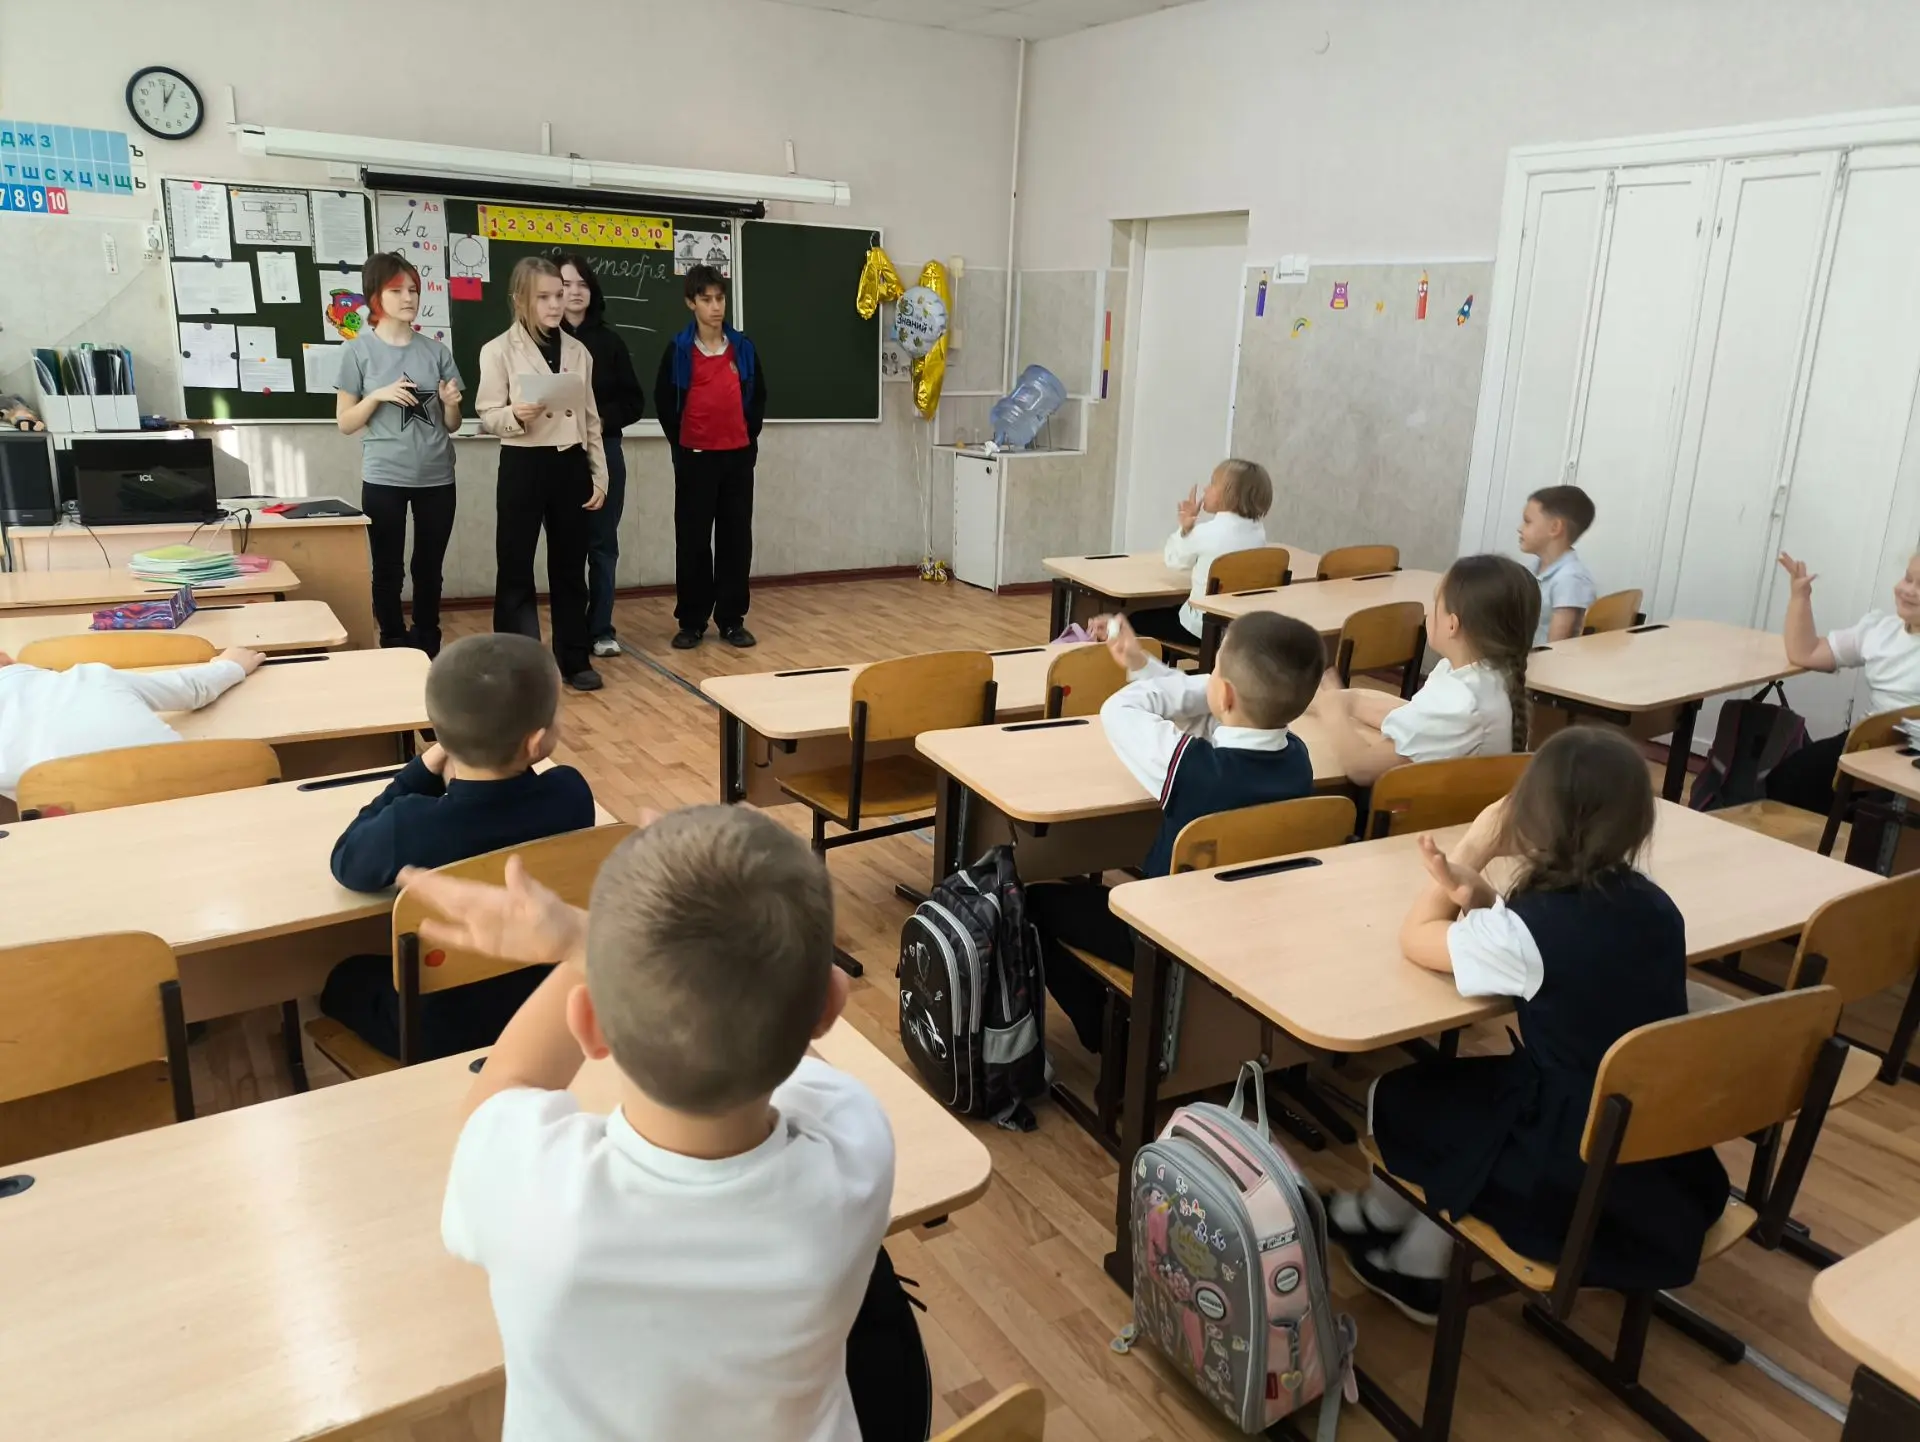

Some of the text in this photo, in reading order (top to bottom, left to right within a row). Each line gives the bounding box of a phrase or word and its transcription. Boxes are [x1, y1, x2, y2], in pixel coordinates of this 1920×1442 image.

[18, 132, 35, 147] Ж
[13, 189, 26, 209] 8
[31, 190, 43, 209] 9
[48, 190, 66, 210] 10
[491, 218, 497, 228] 1
[508, 218, 516, 230] 2
[527, 219, 535, 231] 3
[545, 221, 553, 232] 4
[563, 222, 572, 233] 5
[580, 223, 588, 234] 6
[598, 224, 605, 235] 7
[614, 226, 622, 237] 8
[631, 227, 639, 237] 9
[647, 228, 662, 239] 10
[897, 312, 928, 334] Знаний
[139, 474, 154, 482] ICL
